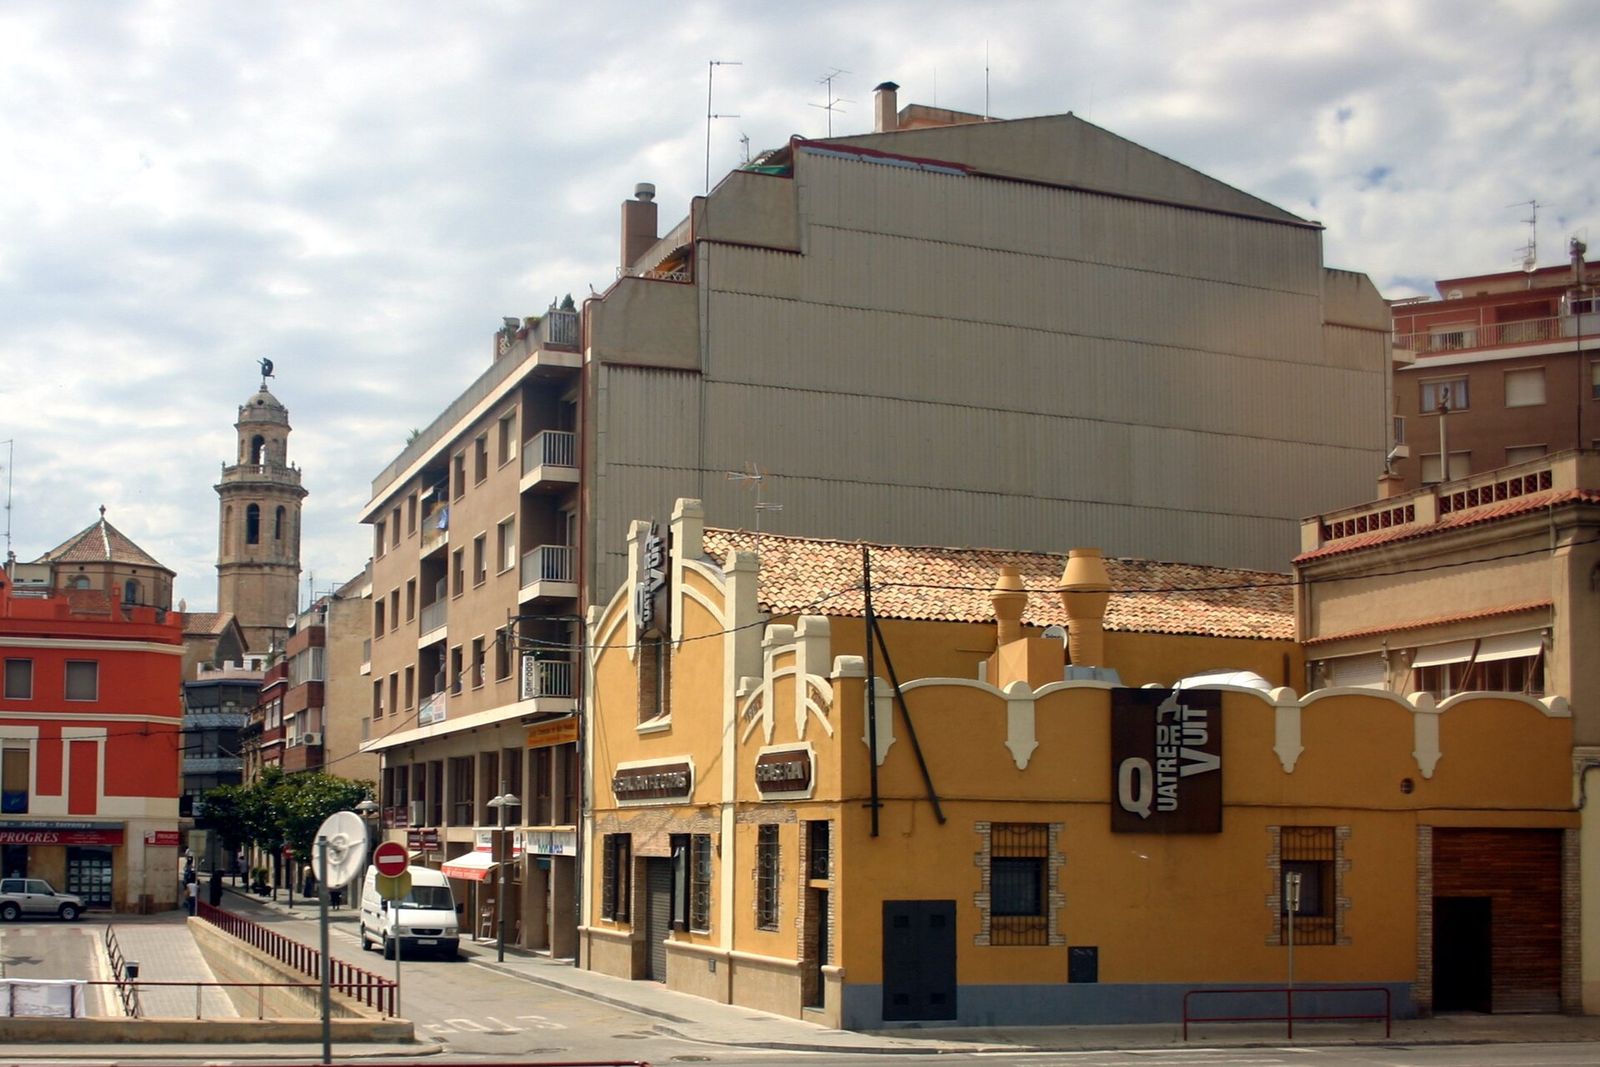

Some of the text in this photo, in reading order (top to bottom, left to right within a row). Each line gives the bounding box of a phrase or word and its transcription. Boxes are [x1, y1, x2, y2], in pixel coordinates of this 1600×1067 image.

[1118, 704, 1221, 820] QUATRE DE VUIT
